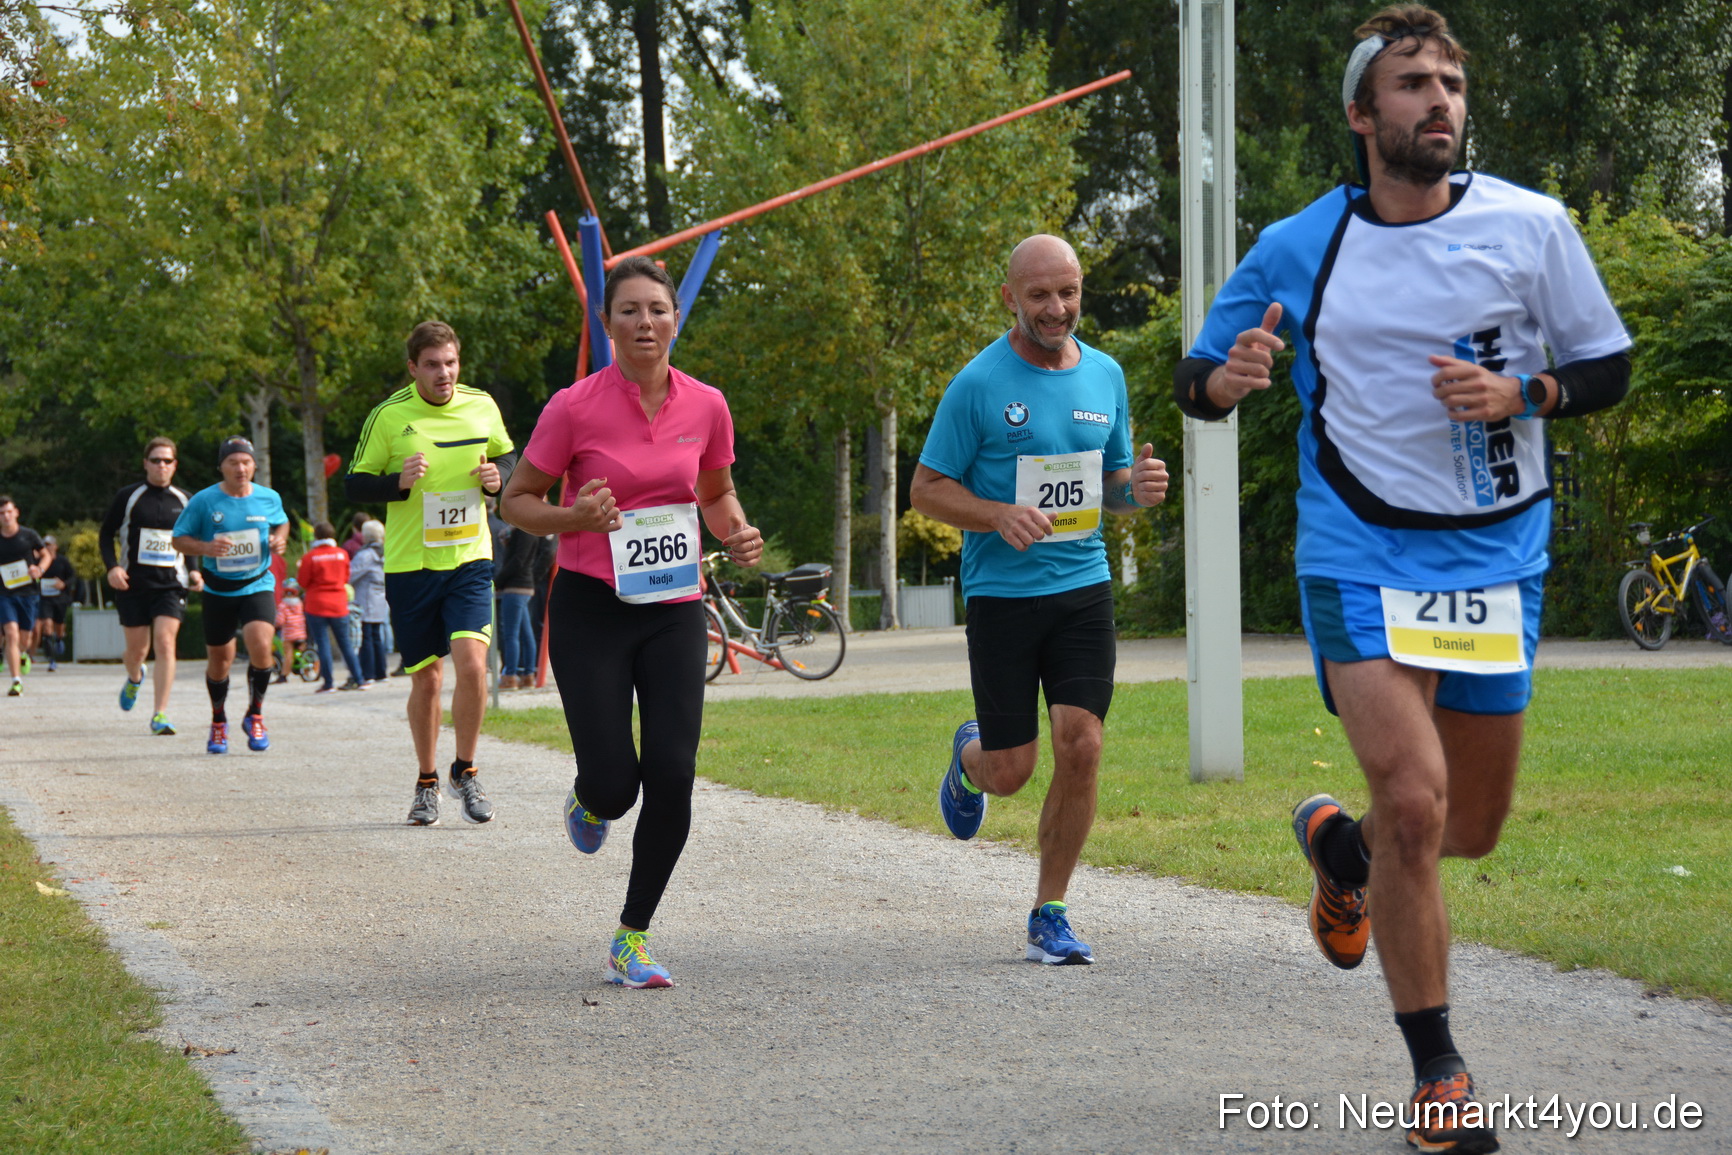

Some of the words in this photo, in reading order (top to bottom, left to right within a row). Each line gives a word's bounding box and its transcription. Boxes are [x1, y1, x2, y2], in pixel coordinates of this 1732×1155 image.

[1072, 409, 1110, 424] BOCK
[1471, 326, 1520, 502] HER
[1007, 429, 1032, 439] PARTL
[1451, 419, 1462, 453] ATER
[1052, 461, 1081, 471] BOCK
[1453, 455, 1469, 501] Solutions
[1038, 480, 1083, 508] 205
[438, 506, 467, 525] 121
[645, 514, 675, 525] BOCK
[1052, 517, 1077, 526] omas
[626, 532, 688, 568] 2566
[649, 573, 673, 585] Nadja
[1415, 588, 1488, 624] 215
[1433, 636, 1475, 651] Daniel
